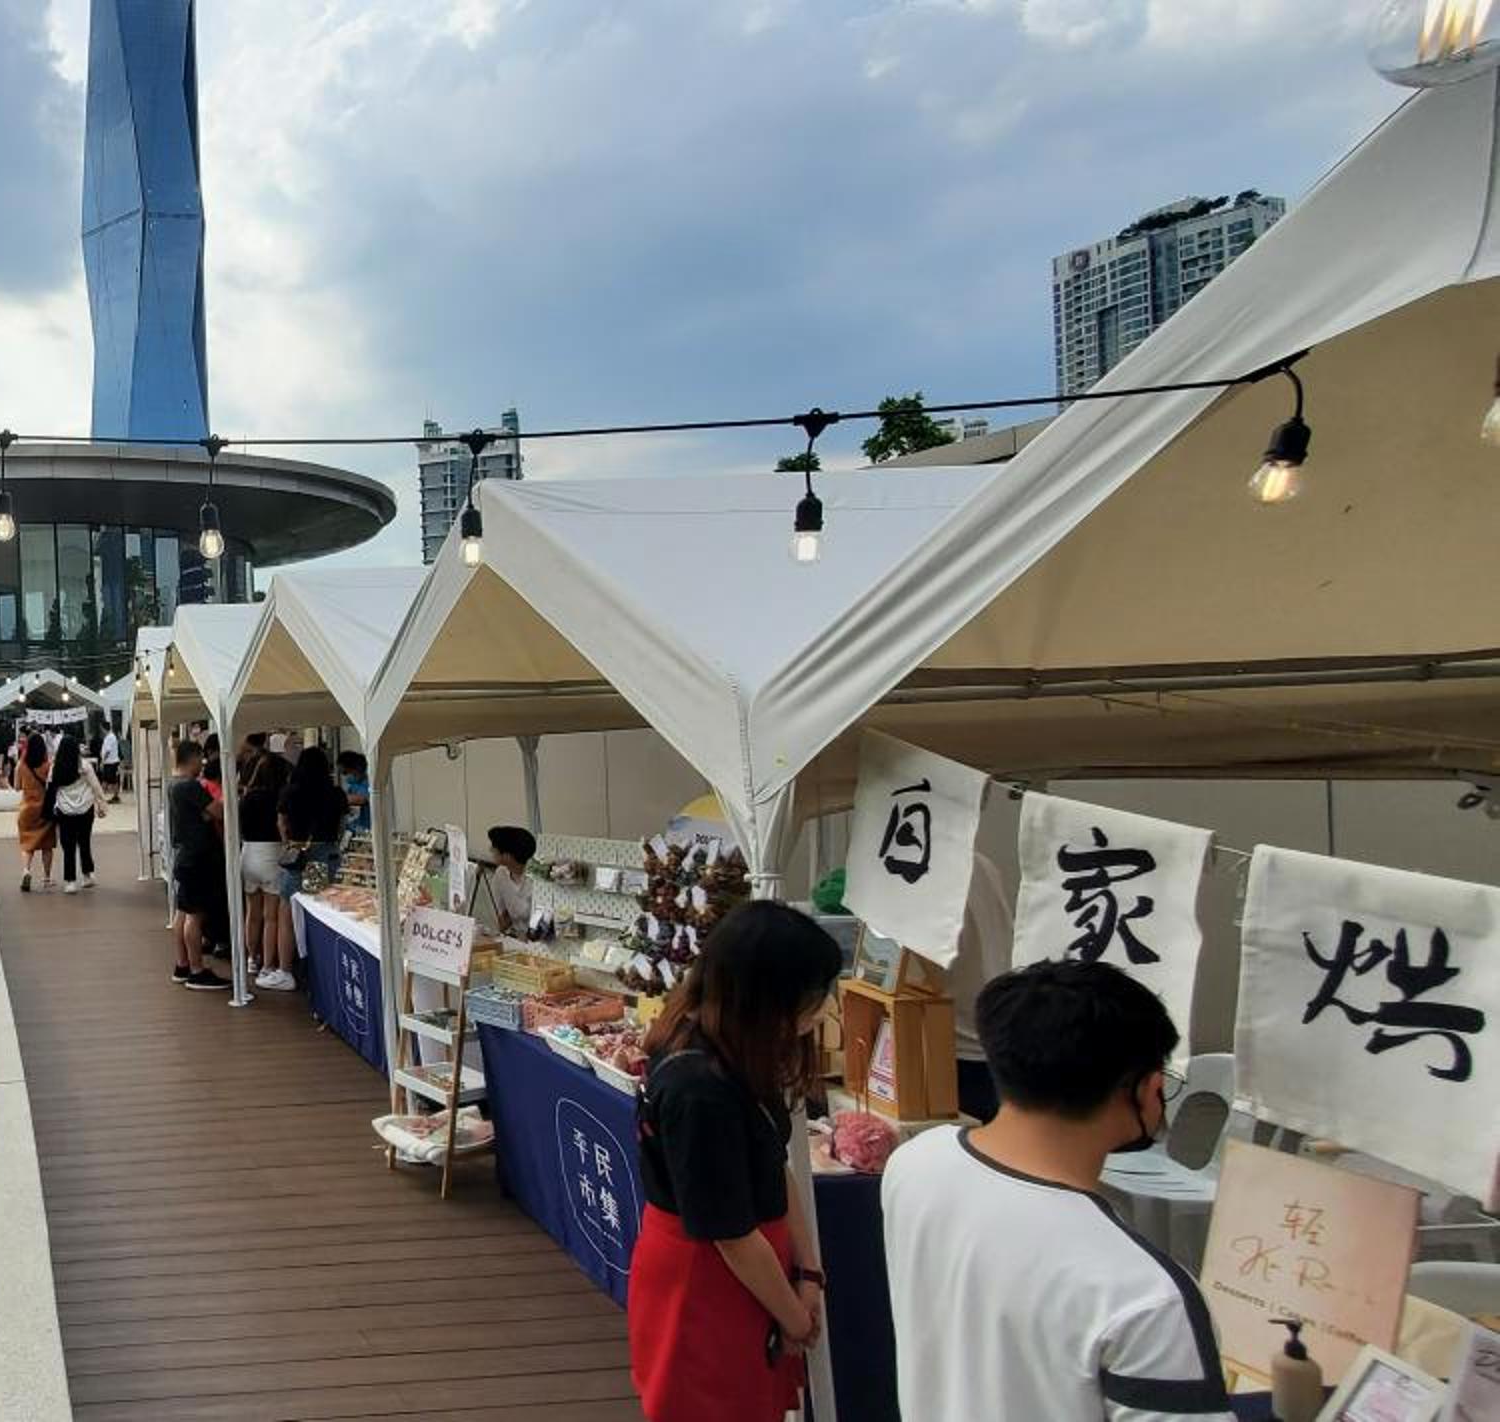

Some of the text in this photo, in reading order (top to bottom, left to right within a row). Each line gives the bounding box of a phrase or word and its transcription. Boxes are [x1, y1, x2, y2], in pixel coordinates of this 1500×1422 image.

[412, 922, 463, 948] DOLCE'S
[1057, 826, 1161, 965] 家
[1301, 919, 1486, 1083] 烘
[1279, 1199, 1326, 1246] 轻
